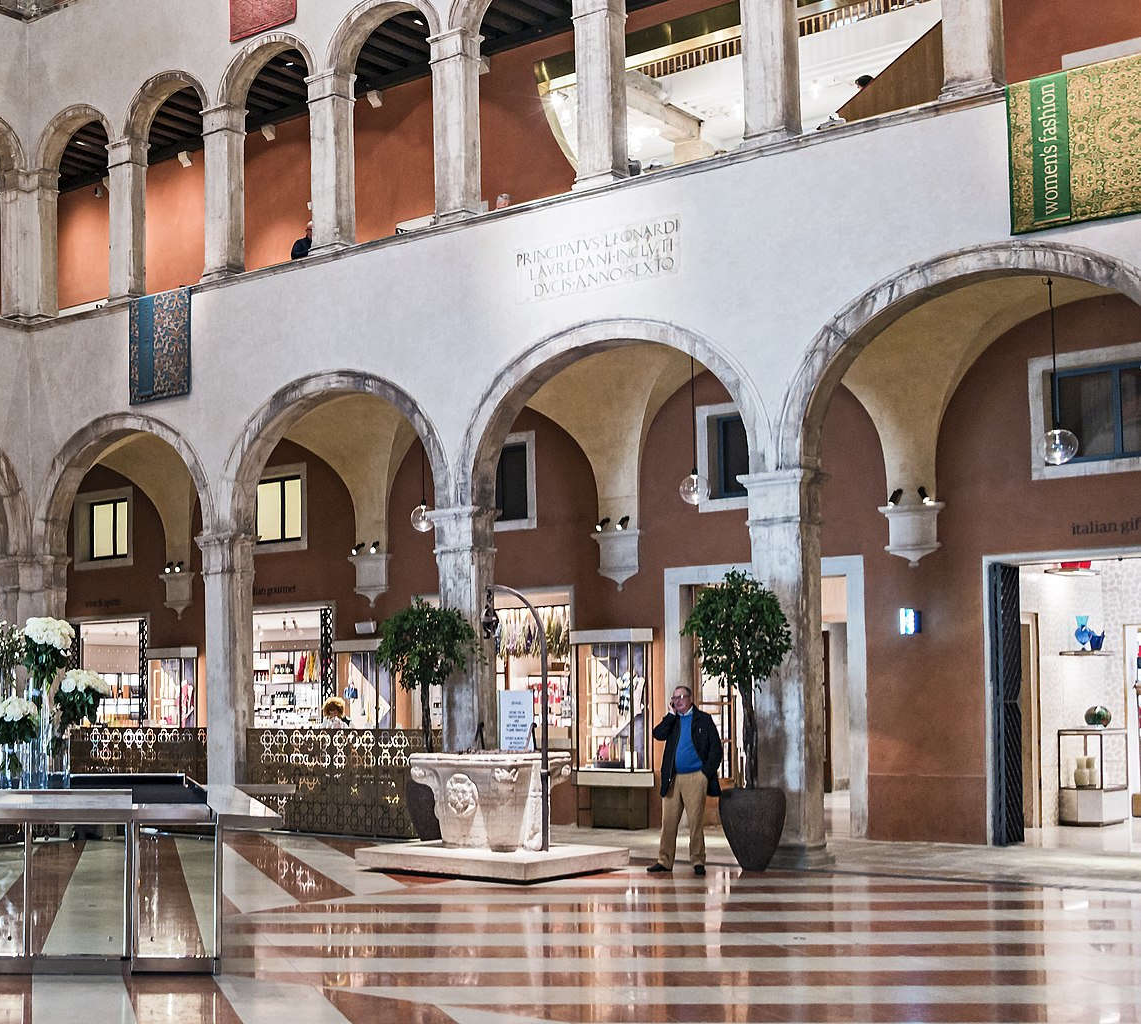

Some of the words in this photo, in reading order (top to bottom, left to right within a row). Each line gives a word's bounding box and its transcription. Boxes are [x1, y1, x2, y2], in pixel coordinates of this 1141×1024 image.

[1038, 81, 1057, 143] fashion
[1040, 145, 1059, 215] women's
[1072, 519, 1117, 536] italian
